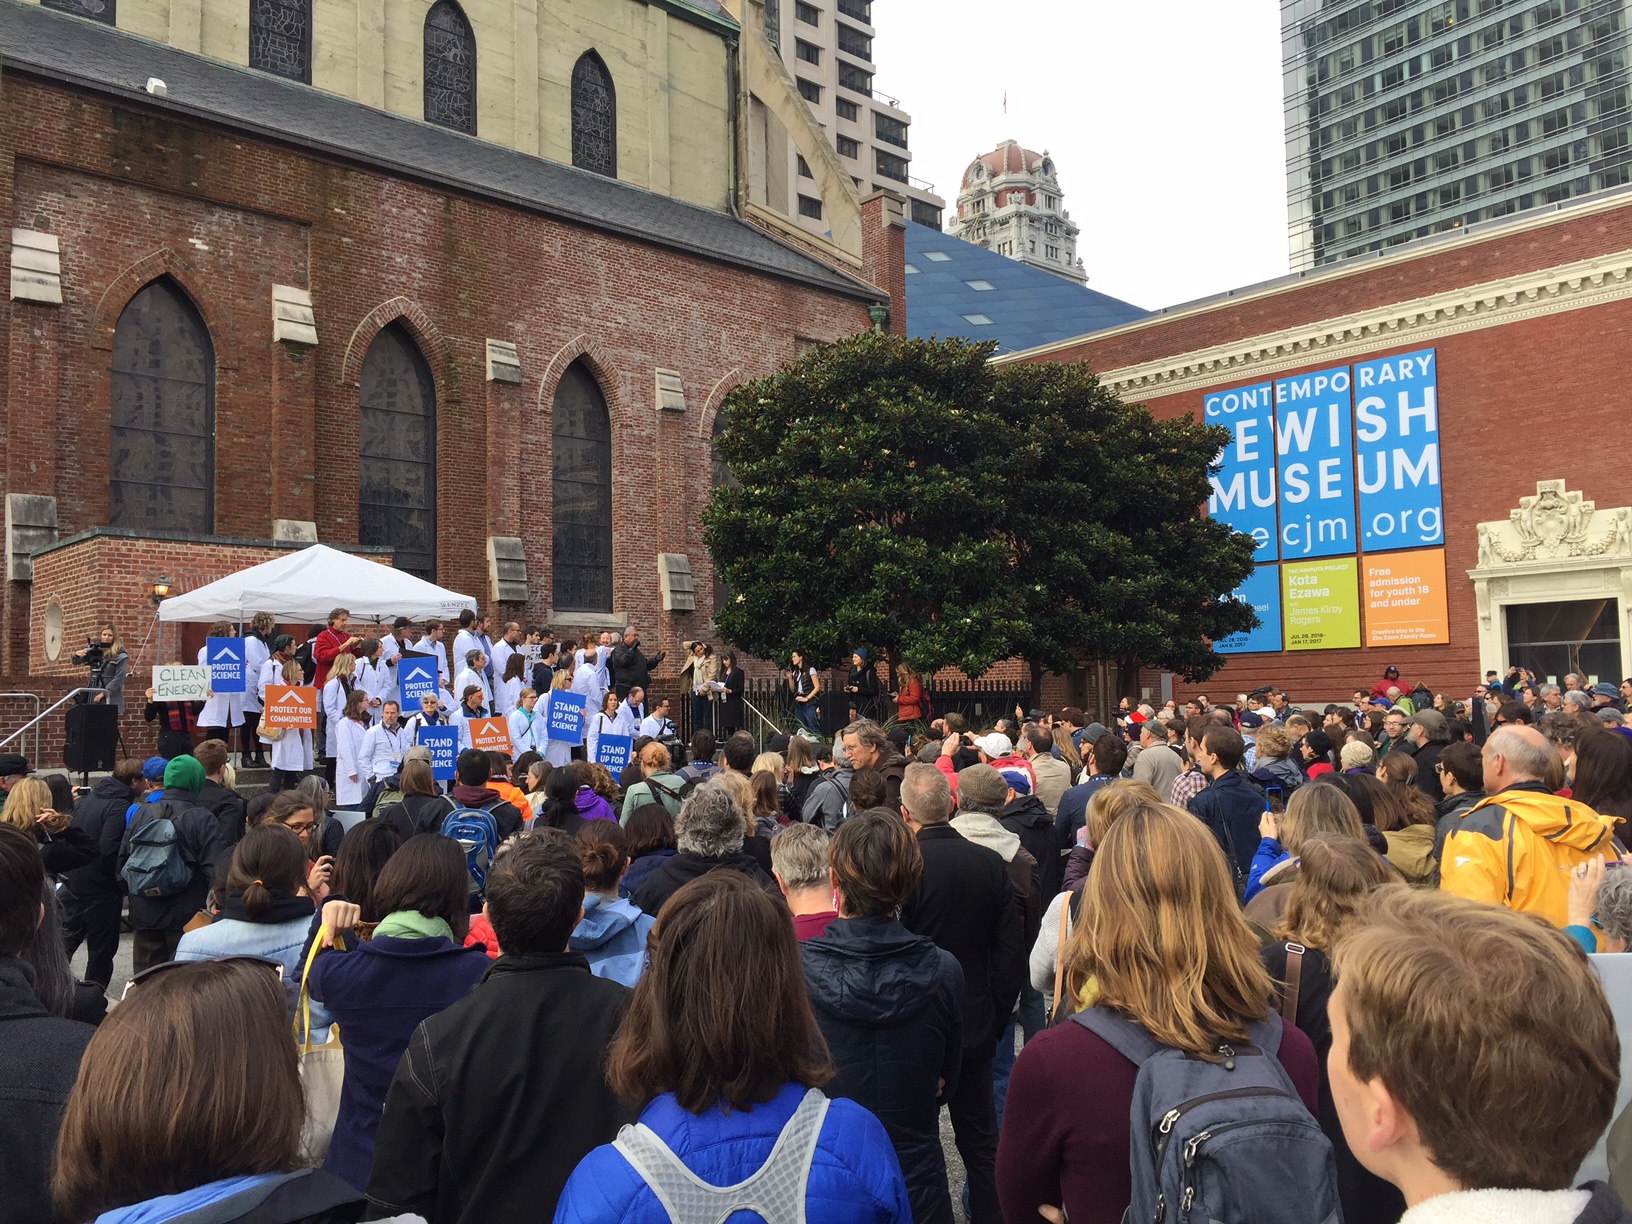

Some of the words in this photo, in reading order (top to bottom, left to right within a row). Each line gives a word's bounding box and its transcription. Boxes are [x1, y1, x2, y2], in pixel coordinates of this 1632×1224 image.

[1208, 443, 1439, 514] MUSEUM
[1228, 507, 1441, 553] ecjm.org
[1369, 568, 1391, 577] Free
[1289, 575, 1318, 586] Kota
[1369, 576, 1421, 587] admission
[1289, 587, 1330, 599] Ezawa
[1370, 589, 1384, 598] for
[1387, 586, 1416, 598] youth
[1418, 585, 1429, 594] 18
[1370, 598, 1389, 608] and
[1391, 597, 1421, 607] under
[1290, 607, 1319, 616] James
[1321, 606, 1343, 614] Kirby
[1290, 616, 1321, 626] Rogers
[212, 663, 241, 671] PROTECT
[160, 668, 207, 682] CLEAN
[212, 671, 241, 680] SCIENCE
[158, 681, 210, 698] ENERGY!
[405, 681, 433, 690] PROTECT
[270, 705, 298, 714] PROTECT
[554, 701, 580, 713] STAND
[270, 715, 312, 724] COMMUNITIES
[552, 712, 563, 720] UP
[564, 713, 579, 723] FOR
[551, 720, 577, 732] SCIENCE
[424, 738, 453, 748] STAND
[475, 736, 496, 745] PROTECT
[436, 749, 453, 758] FOR
[601, 744, 626, 755] STAND
[600, 755, 610, 763] UP
[610, 756, 625, 764] FOR
